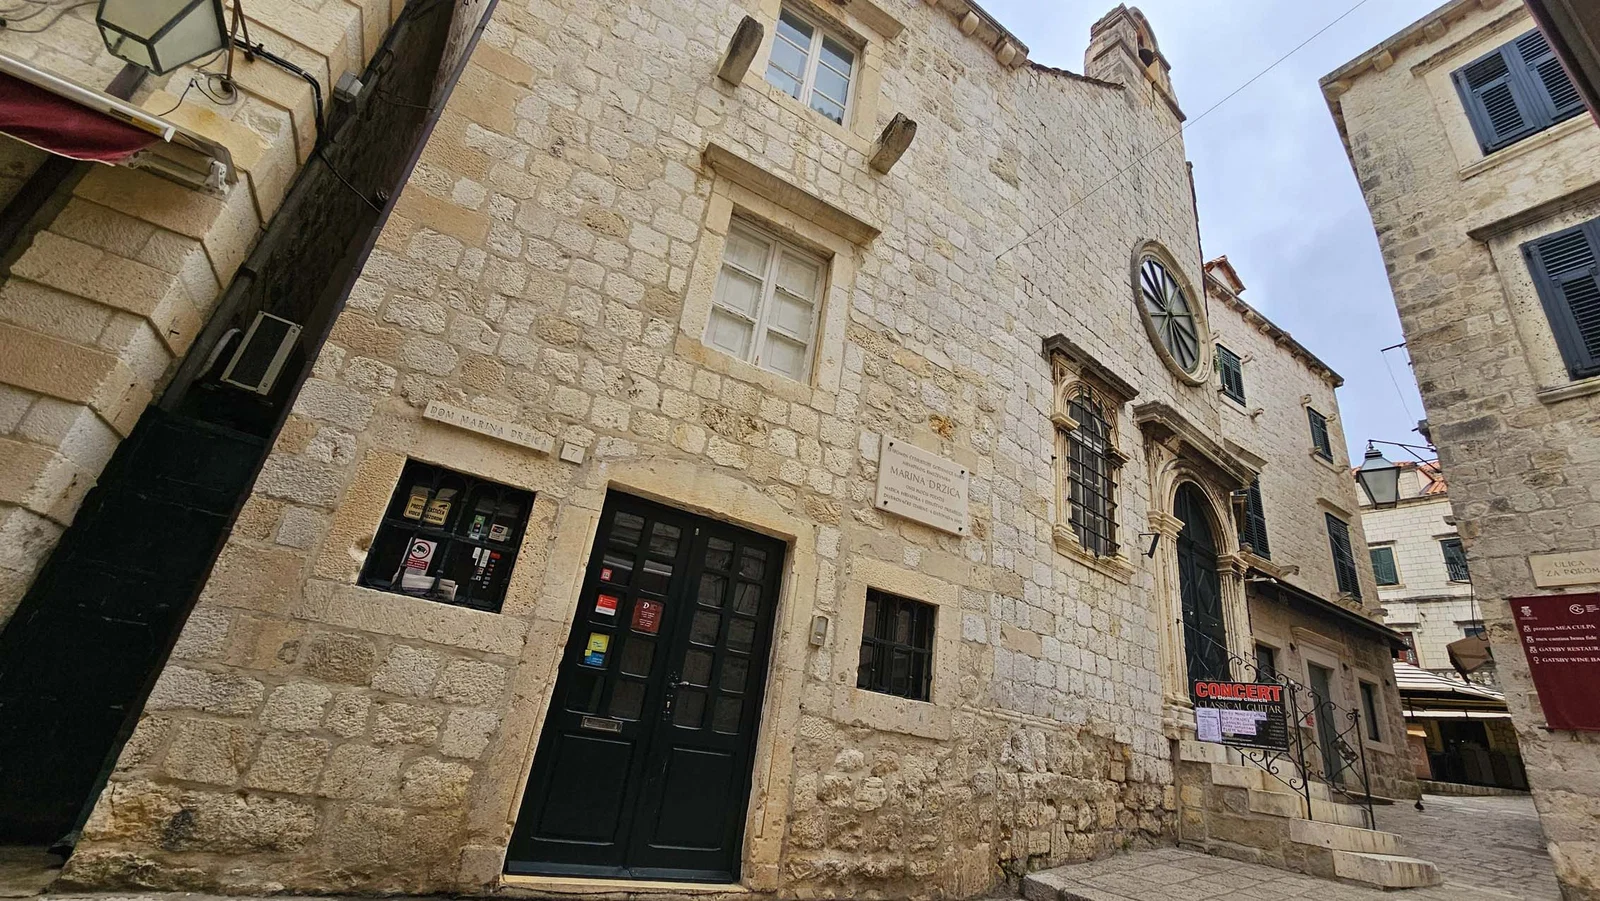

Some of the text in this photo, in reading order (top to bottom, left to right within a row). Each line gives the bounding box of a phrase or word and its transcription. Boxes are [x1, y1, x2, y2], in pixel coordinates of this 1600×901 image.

[430, 405, 455, 420] DOM
[460, 415, 505, 434] MARINA
[570, 447, 578, 458] 7
[890, 465, 926, 486] MARINA
[1554, 560, 1585, 568] ULICA
[1196, 682, 1282, 702] CONCERT
[1198, 700, 1283, 714] CLASSICAL GUITAR
